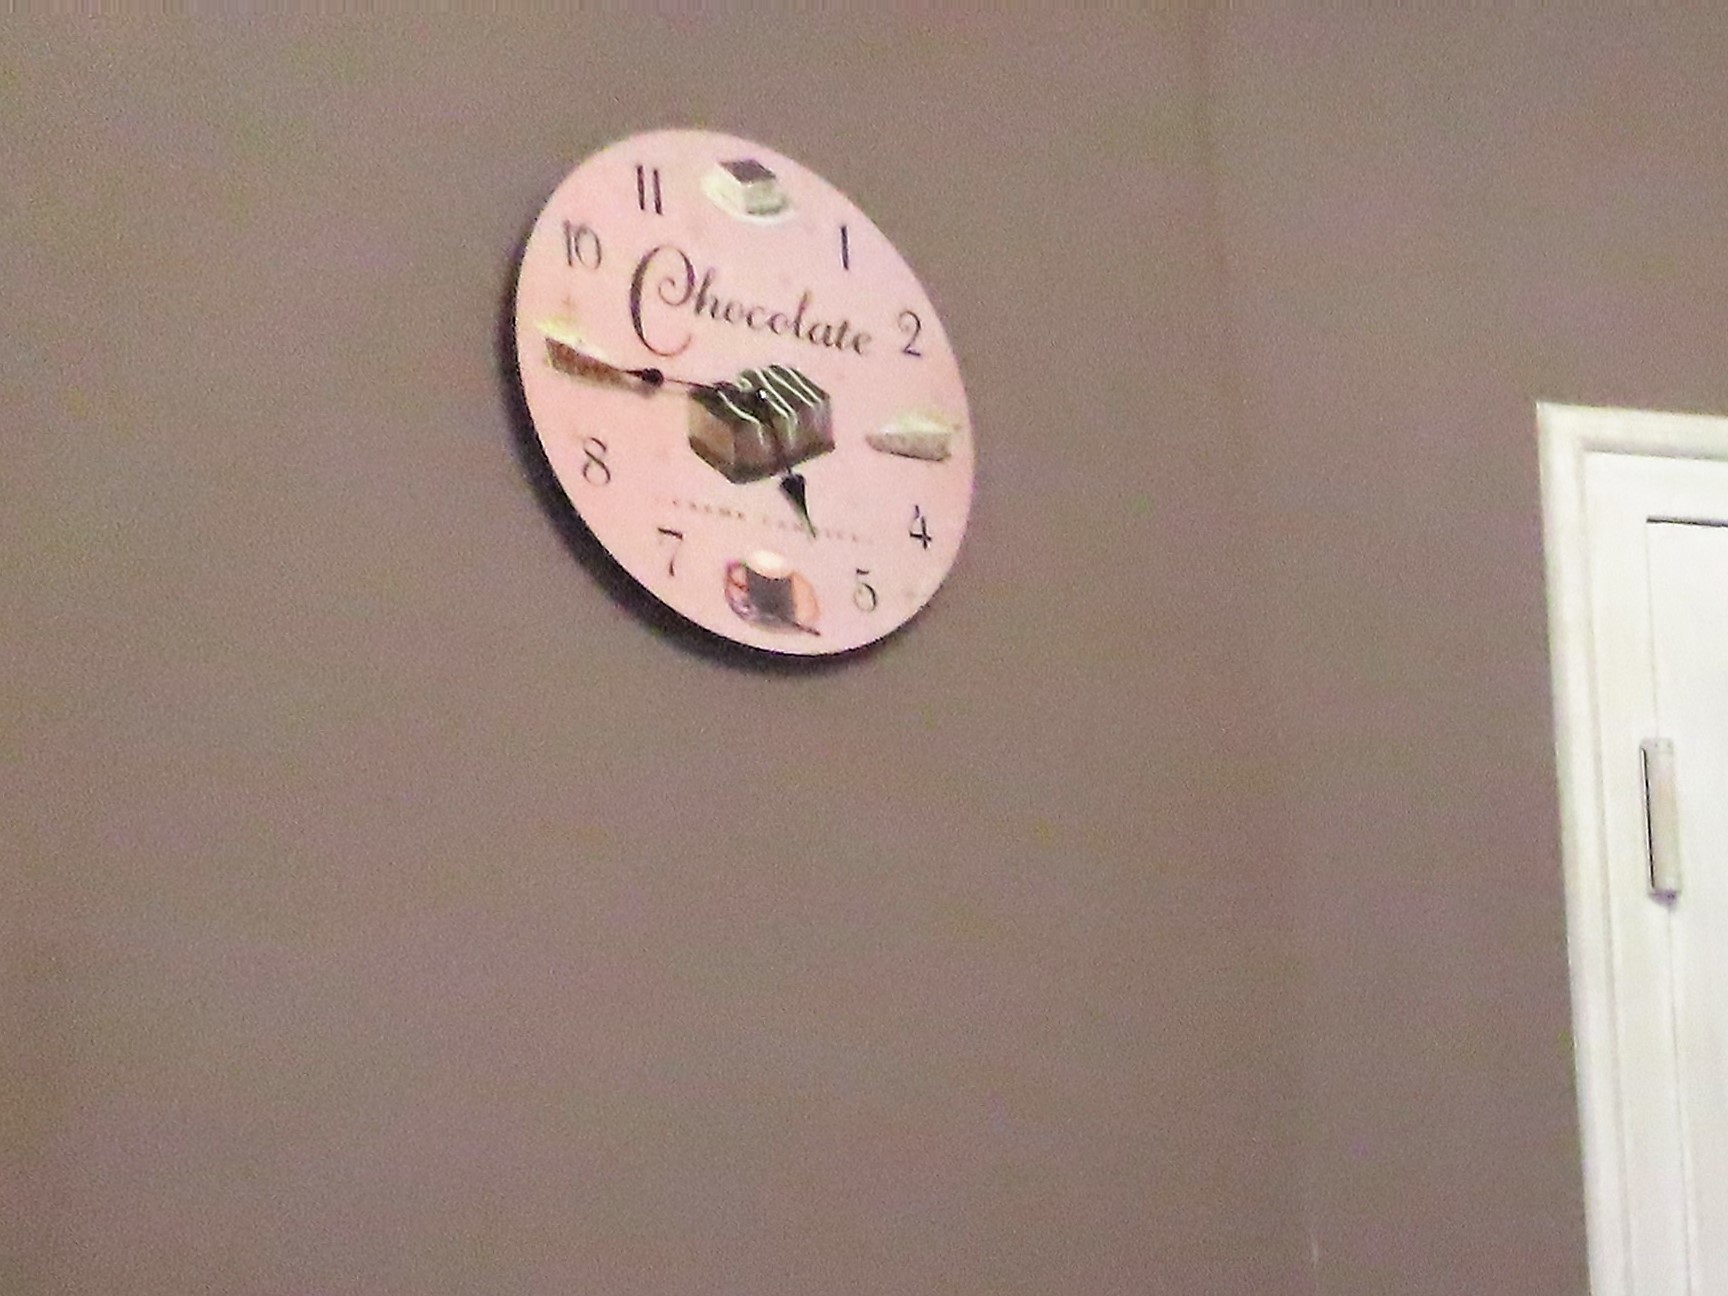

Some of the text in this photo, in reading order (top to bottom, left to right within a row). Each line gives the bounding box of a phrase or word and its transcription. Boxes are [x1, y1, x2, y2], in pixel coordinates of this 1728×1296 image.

[634, 164, 664, 215] 11
[562, 218, 603, 271] 10
[839, 224, 851, 272] 1
[628, 243, 873, 357] Chocolate
[897, 309, 923, 357] 2
[583, 436, 611, 486] 8
[656, 525, 684, 578] 7
[907, 503, 934, 551] 4
[853, 568, 879, 613] 5
